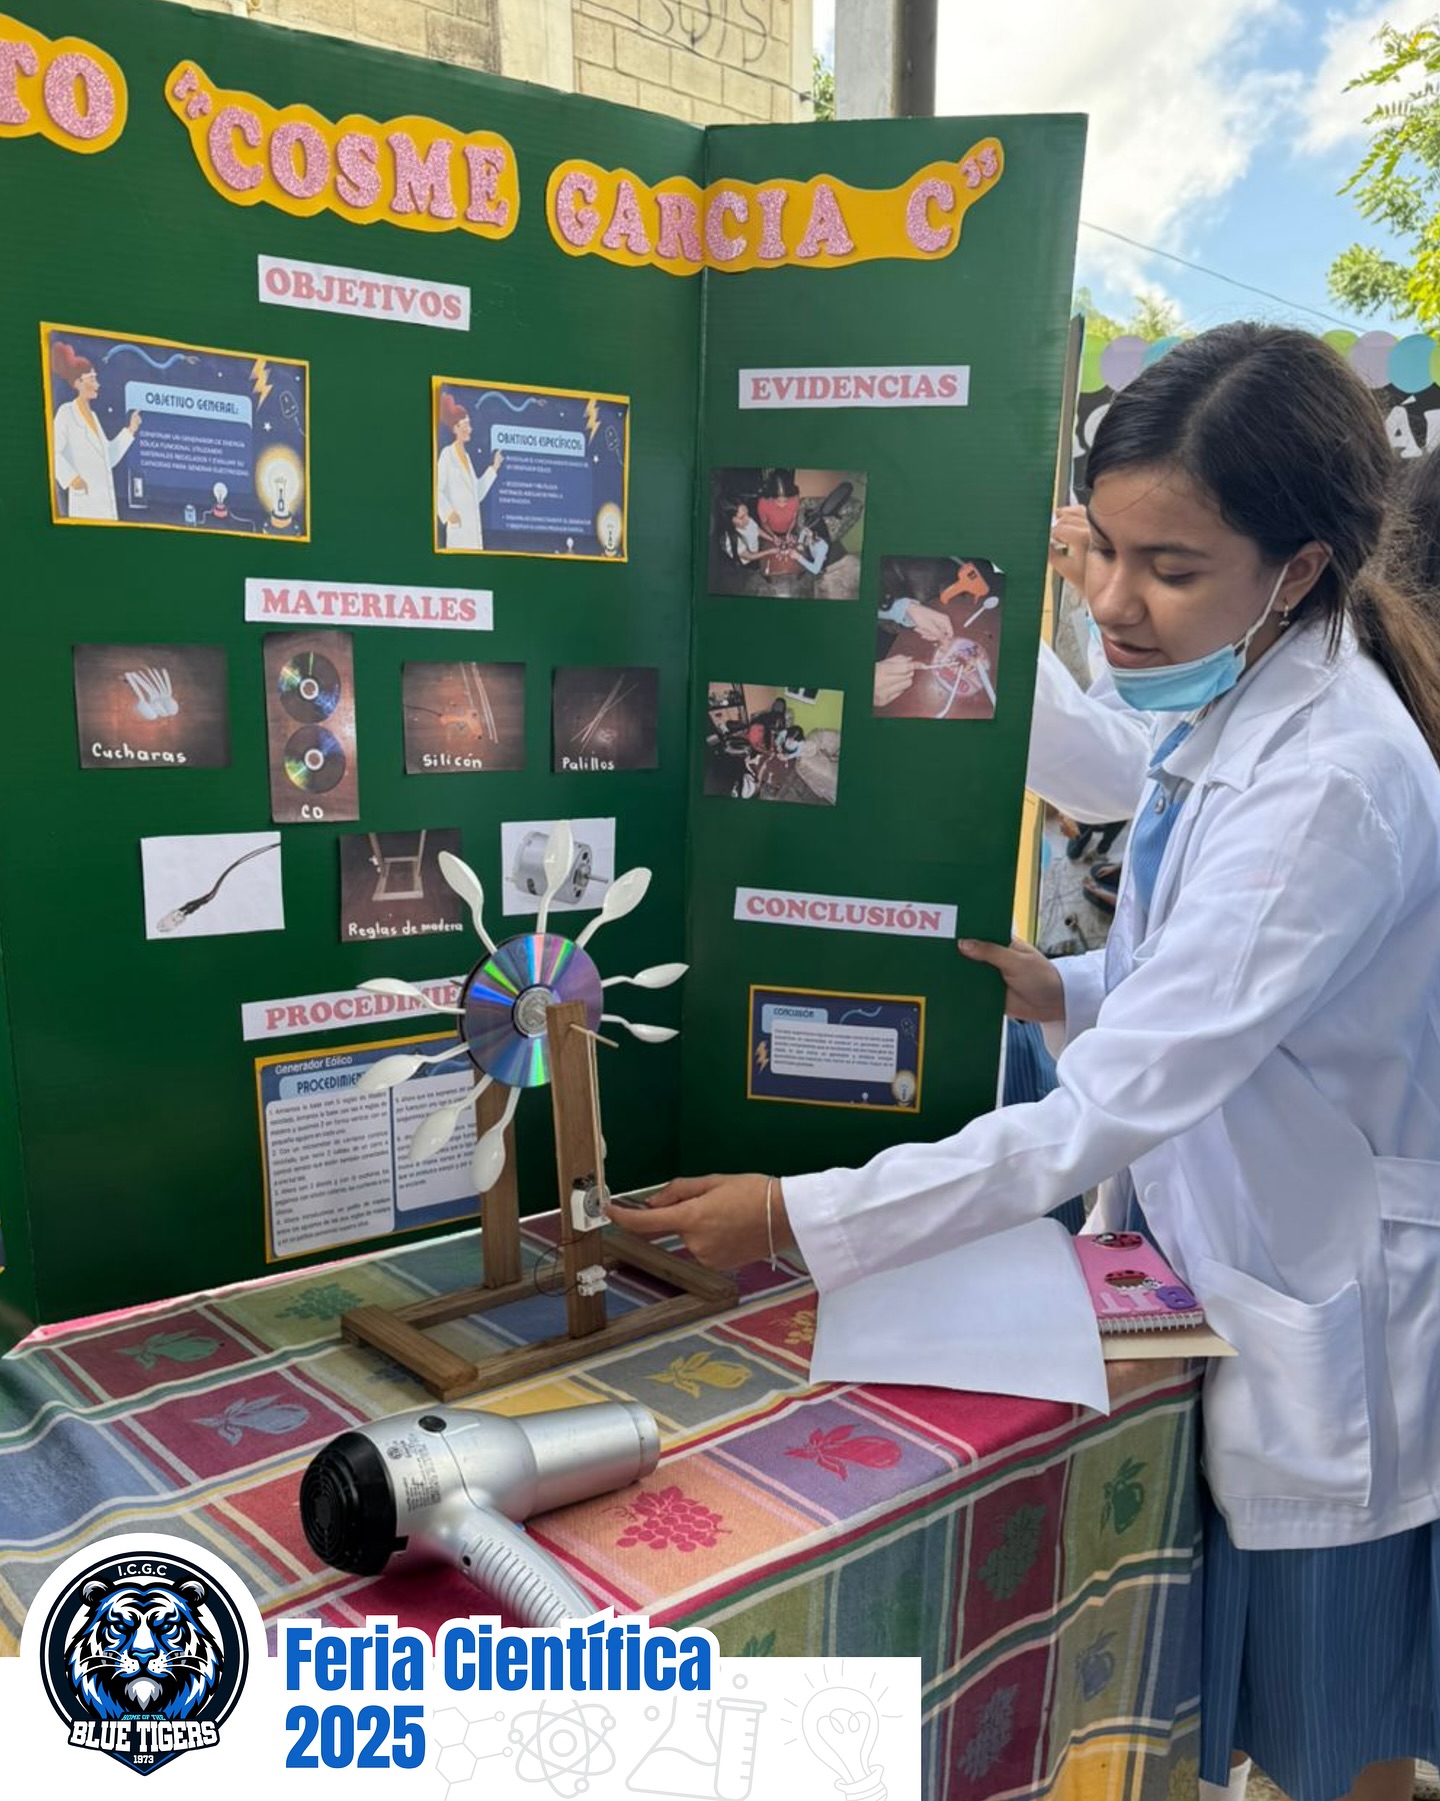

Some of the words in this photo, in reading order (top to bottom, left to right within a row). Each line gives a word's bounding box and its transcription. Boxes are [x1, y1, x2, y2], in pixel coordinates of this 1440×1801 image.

[556, 171, 854, 262] GARCIA
[265, 267, 462, 320] OBJETIVOS
[751, 373, 957, 400] EVIDENCIAS
[145, 392, 194, 409] OBJETIVO
[262, 588, 476, 622] MATERIALES
[92, 742, 187, 763] Cucharas
[422, 753, 483, 769] Silicón
[562, 751, 615, 770] Palillos
[747, 896, 941, 931] CONCLUSIÓN
[348, 922, 398, 939] Reglas
[402, 920, 418, 936] de
[421, 918, 463, 933] madera
[265, 984, 459, 1030] PROCEDIMIE
[275, 1058, 324, 1075] Generador
[325, 1055, 353, 1068] Eólico
